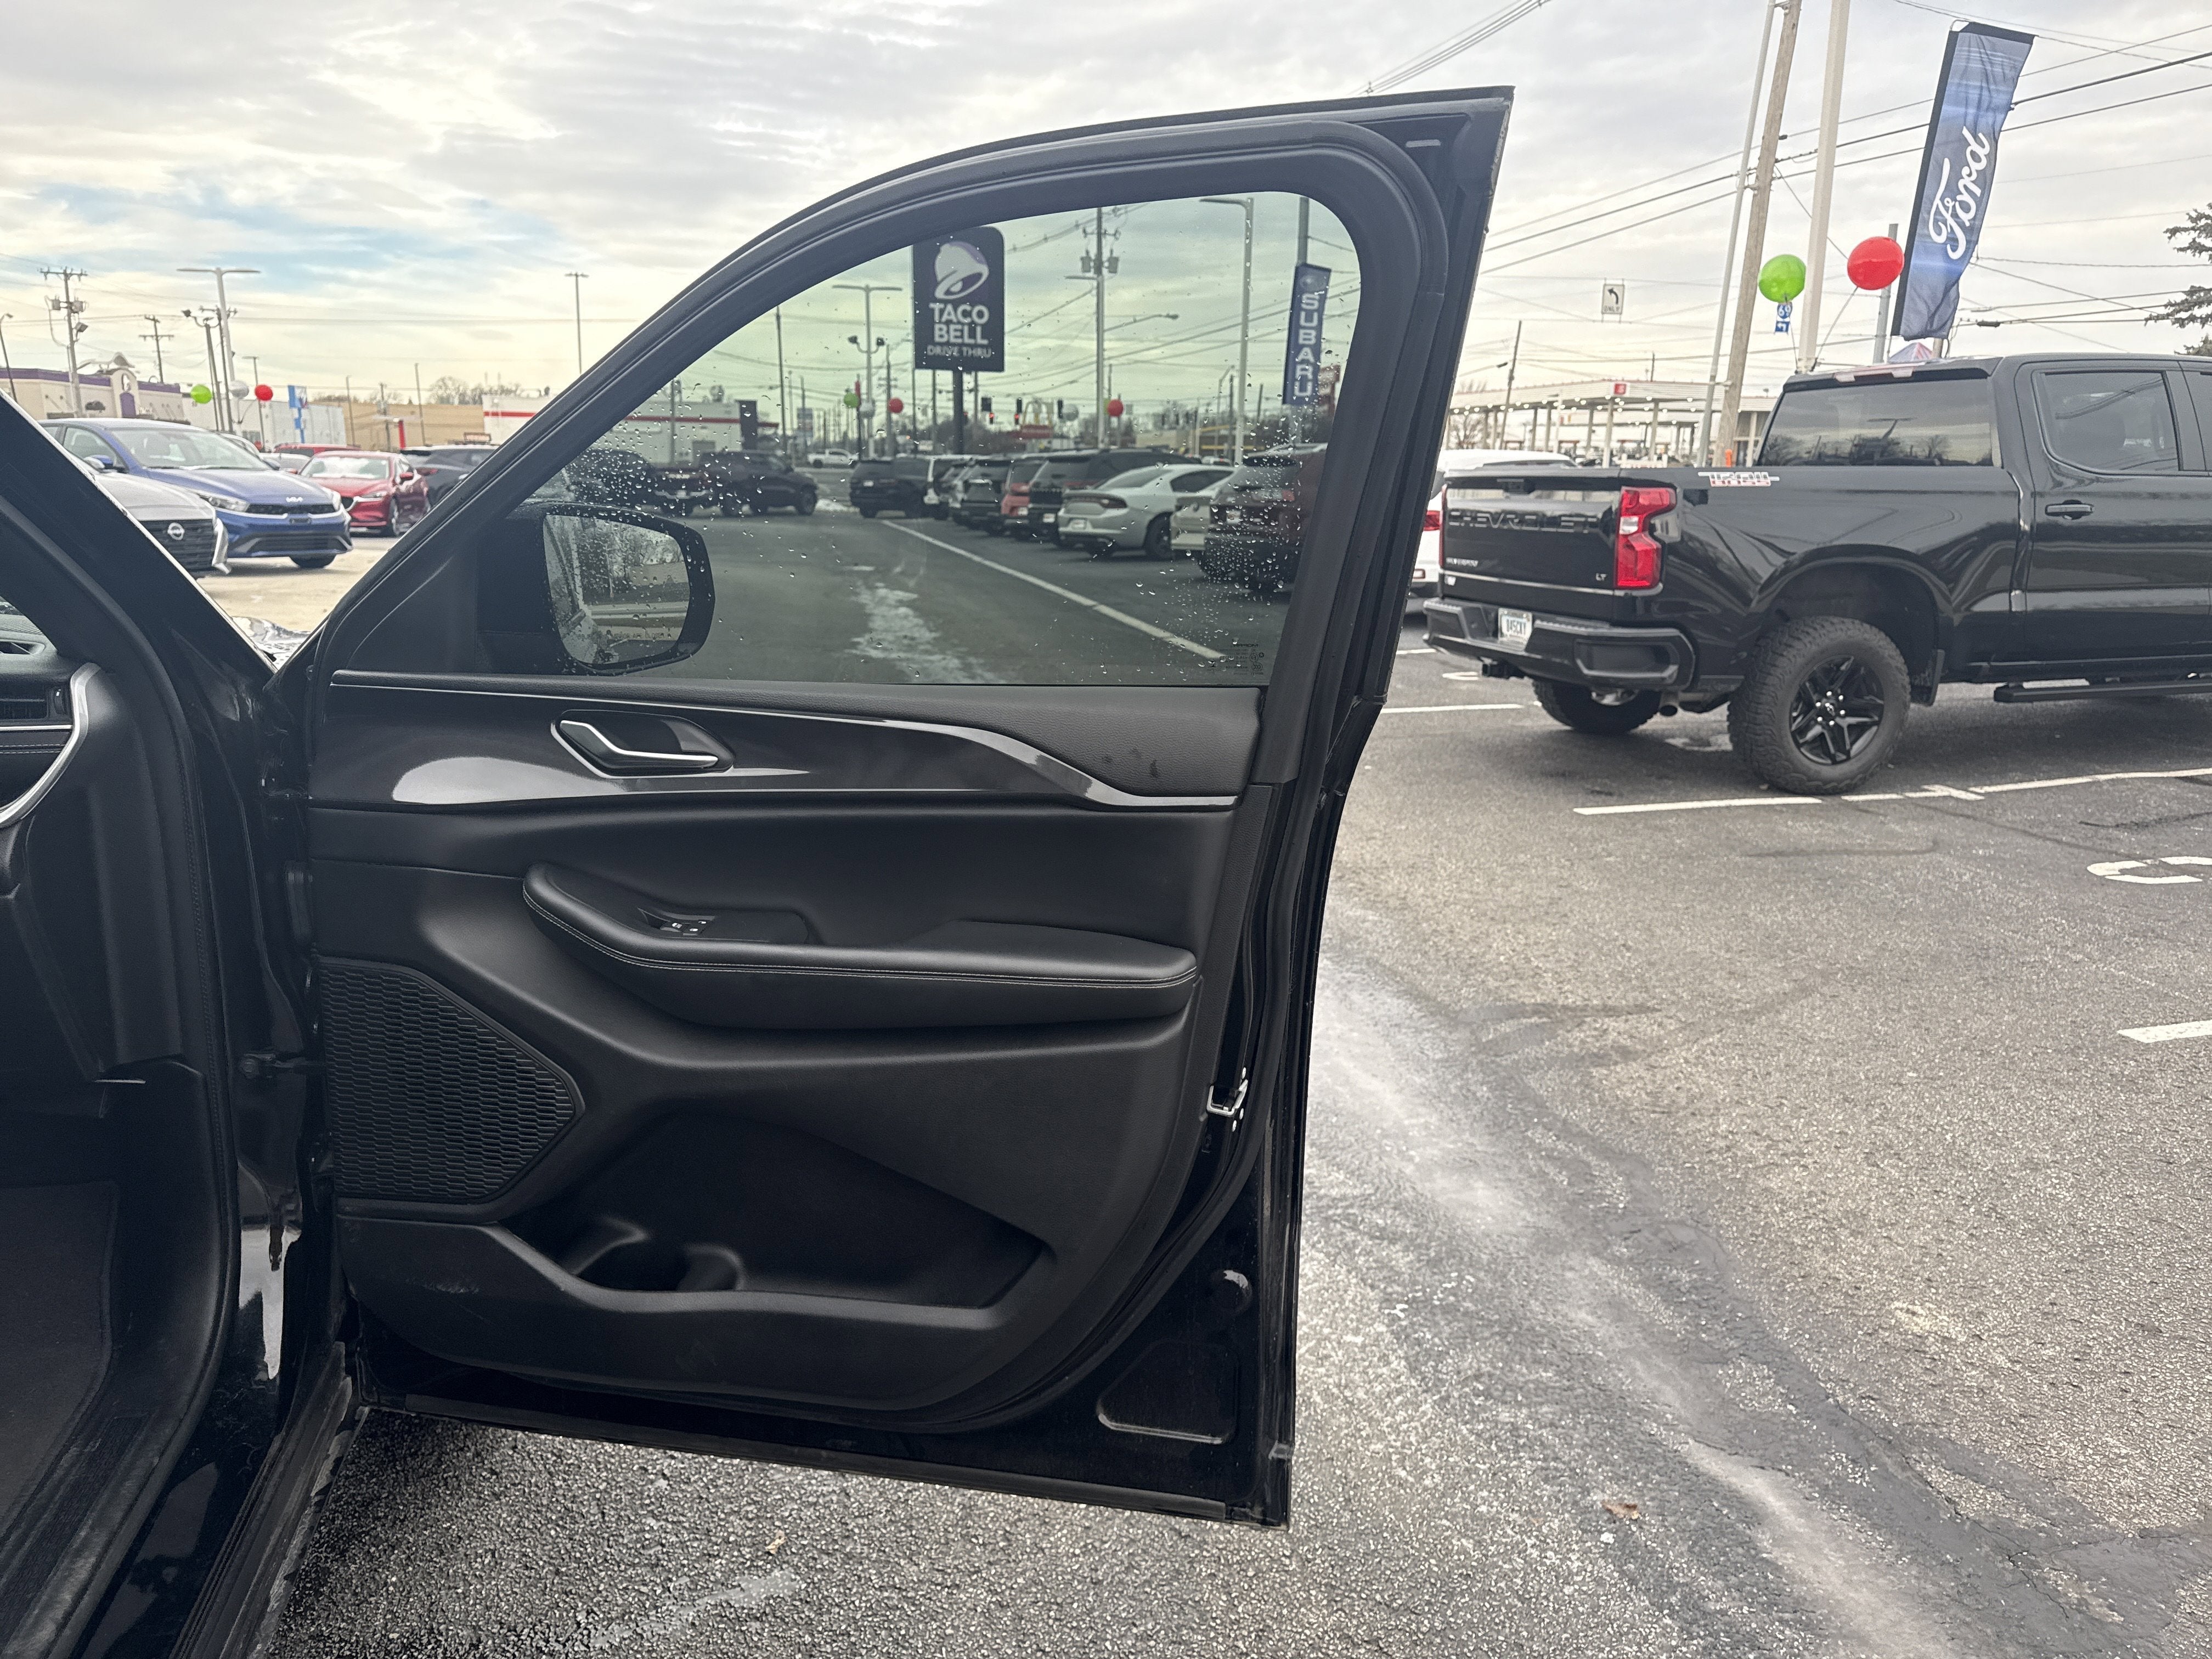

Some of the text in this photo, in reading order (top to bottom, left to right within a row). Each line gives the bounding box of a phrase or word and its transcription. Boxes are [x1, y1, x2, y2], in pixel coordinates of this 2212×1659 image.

[1928, 126, 1990, 259] Ford
[928, 303, 989, 324] TACO
[934, 324, 989, 345] BELL
[1294, 292, 1319, 397] SUBARU
[962, 346, 992, 358] THRU
